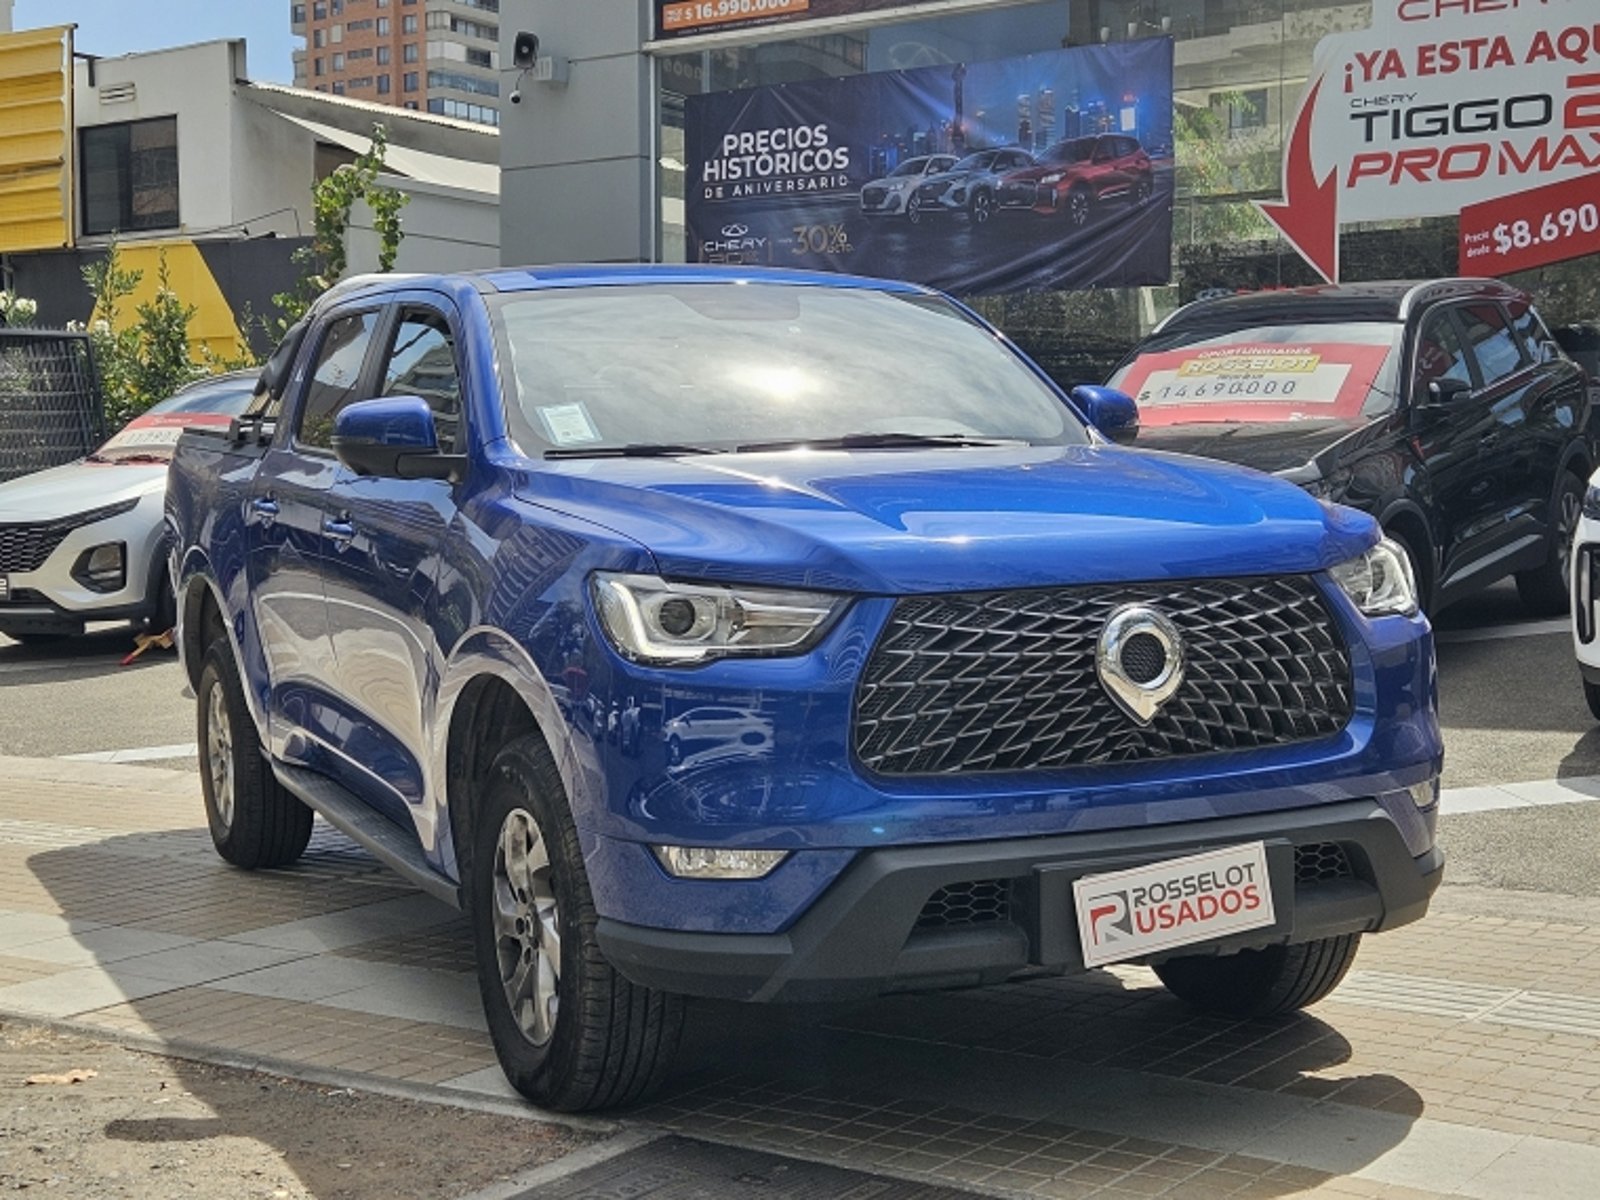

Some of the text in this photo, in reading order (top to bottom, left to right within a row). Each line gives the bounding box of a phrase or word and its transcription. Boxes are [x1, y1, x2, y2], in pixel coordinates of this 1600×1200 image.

[1343, 24, 1600, 93] ¡YA ESTA AQ
[1349, 93, 1553, 142] TIGGO
[1350, 92, 1418, 108] CHERY
[722, 123, 829, 157] PRECIOS
[704, 174, 849, 199] DE ANIVERSARIO
[704, 237, 767, 252] CHERY
[1131, 862, 1256, 908] ROSSELOT
[1135, 885, 1261, 934] USADOS
